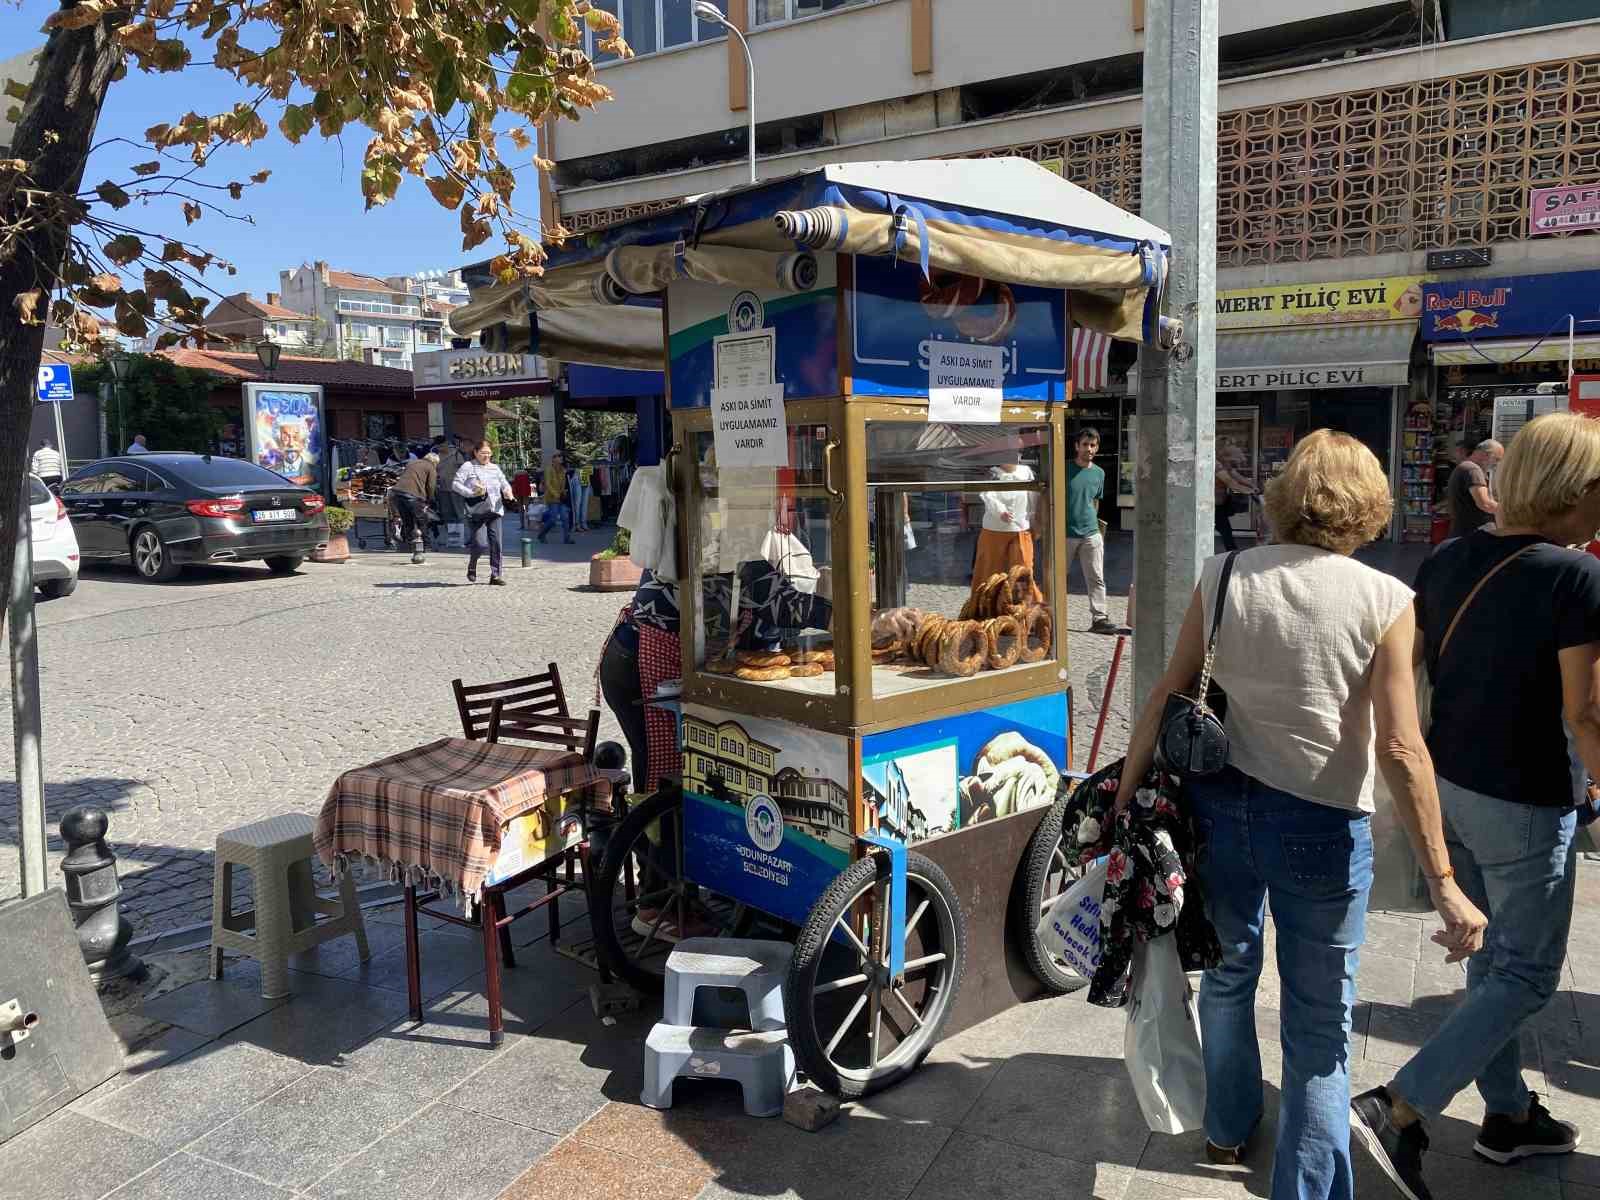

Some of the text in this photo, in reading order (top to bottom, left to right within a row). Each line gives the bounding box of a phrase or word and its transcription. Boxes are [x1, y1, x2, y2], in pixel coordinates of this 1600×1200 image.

[1545, 191, 1600, 211] SAF
[1216, 282, 1386, 313] MERT PİLİÇ EVİ
[1426, 287, 1505, 311] Red Bull
[941, 355, 958, 366] ASKI
[960, 356, 970, 367] DA
[937, 375, 995, 388] UYGULAMAMIZ
[1216, 367, 1364, 388] ERT PİLİÇ EVİ
[720, 401, 736, 412] ASKI
[738, 400, 749, 410] DA
[953, 395, 981, 406] VARDIR
[719, 417, 778, 431] UYGULAMAMIZ
[734, 438, 764, 449] VARDIR
